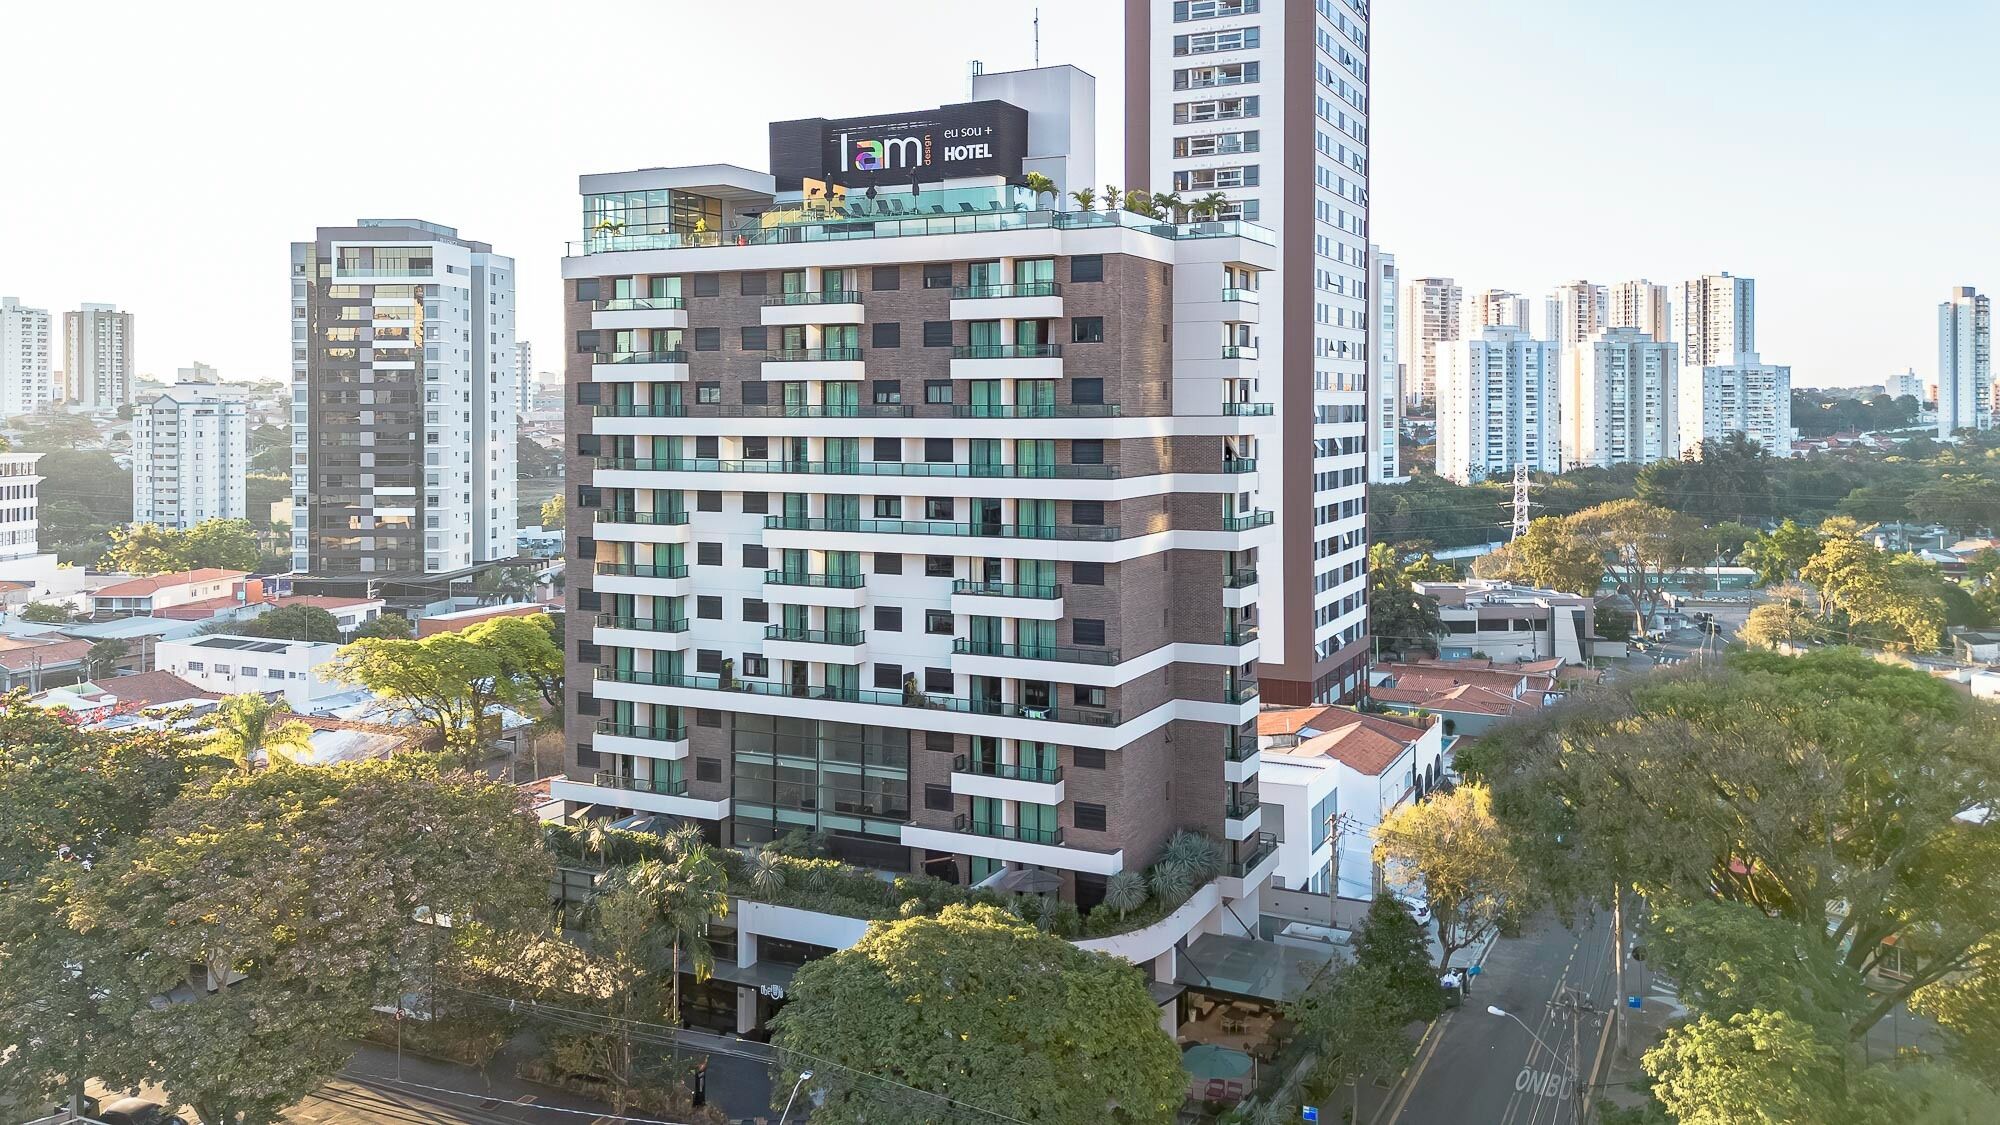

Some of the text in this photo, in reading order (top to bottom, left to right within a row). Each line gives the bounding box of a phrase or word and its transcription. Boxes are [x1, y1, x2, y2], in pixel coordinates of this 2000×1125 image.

[944, 129, 958, 138] eu
[961, 127, 981, 137] sou
[855, 136, 922, 171] am
[944, 143, 993, 161] HOTEL
[1515, 1065, 1573, 1100] ÔNIBU
